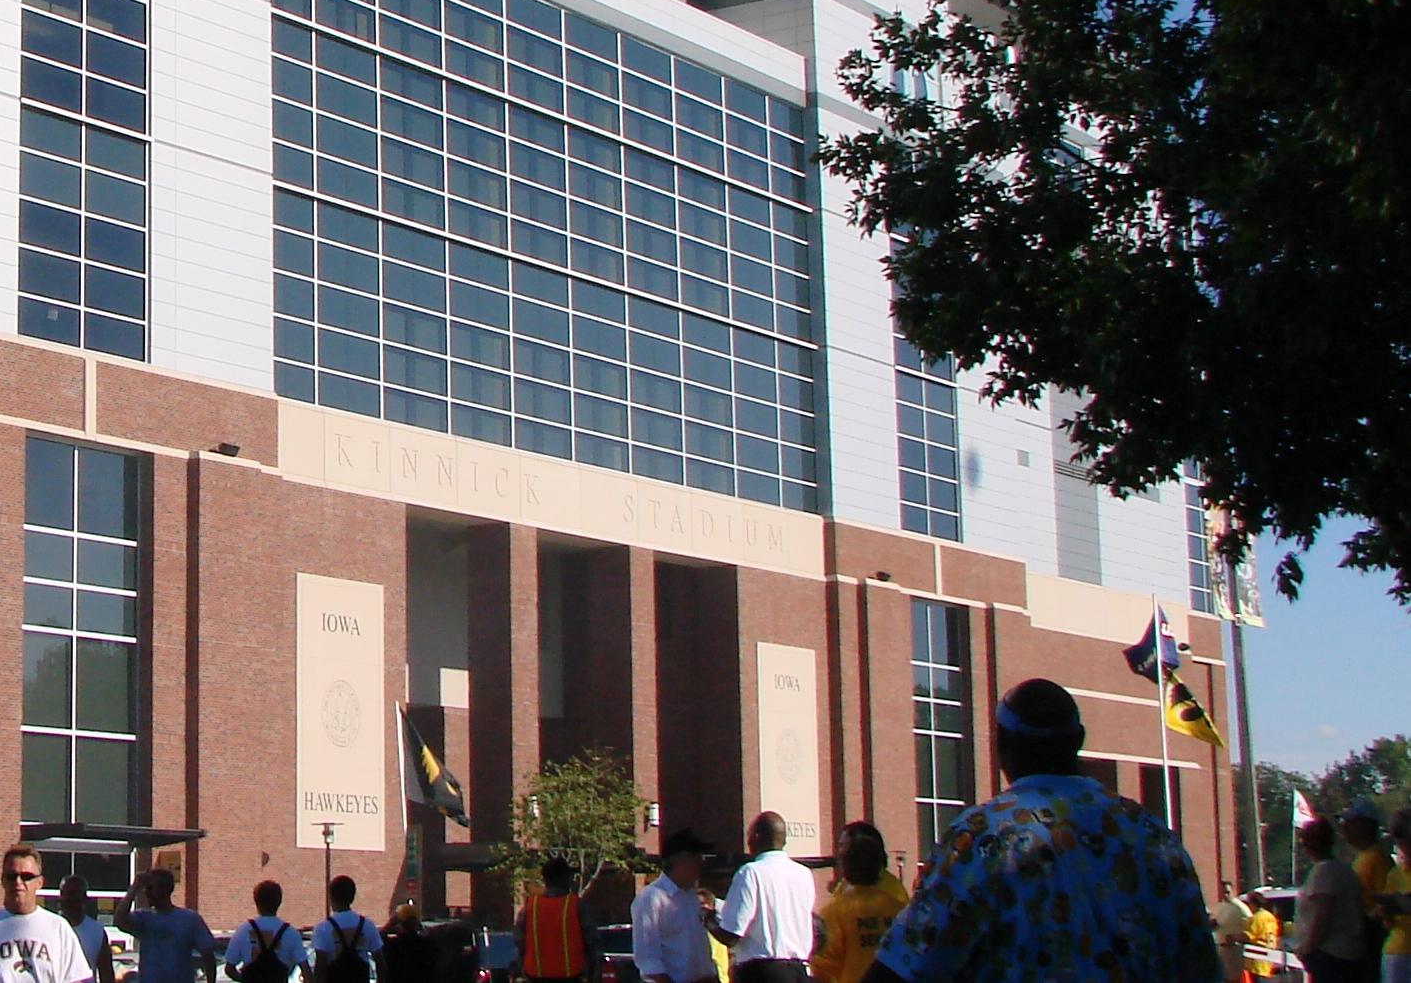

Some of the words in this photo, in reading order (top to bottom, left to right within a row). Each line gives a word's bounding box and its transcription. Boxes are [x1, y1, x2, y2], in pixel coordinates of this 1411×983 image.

[334, 433, 541, 505] KINNICK
[623, 495, 784, 552] STADIUM
[321, 612, 361, 636] IOWA
[774, 674, 801, 692] IOWA
[304, 791, 379, 815] HAWKEYES
